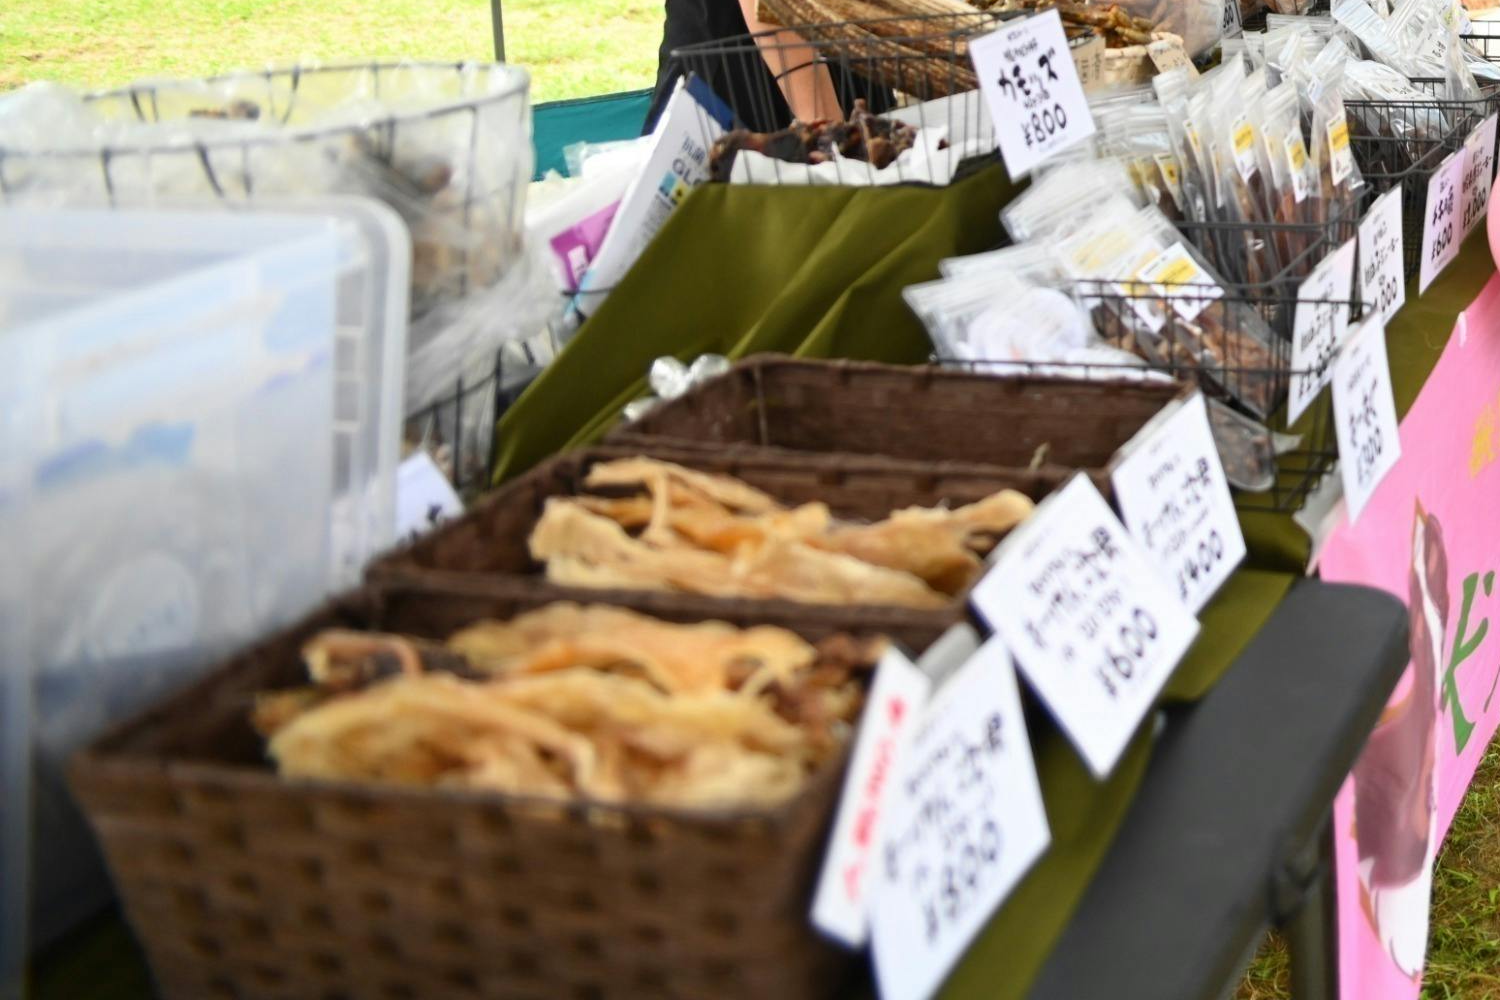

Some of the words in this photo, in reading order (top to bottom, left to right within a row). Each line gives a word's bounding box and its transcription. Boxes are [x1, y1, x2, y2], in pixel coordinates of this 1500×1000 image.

[1020, 102, 1068, 148] ¥800
[1430, 223, 1454, 262] ¥600
[1097, 607, 1161, 701] ¥600
